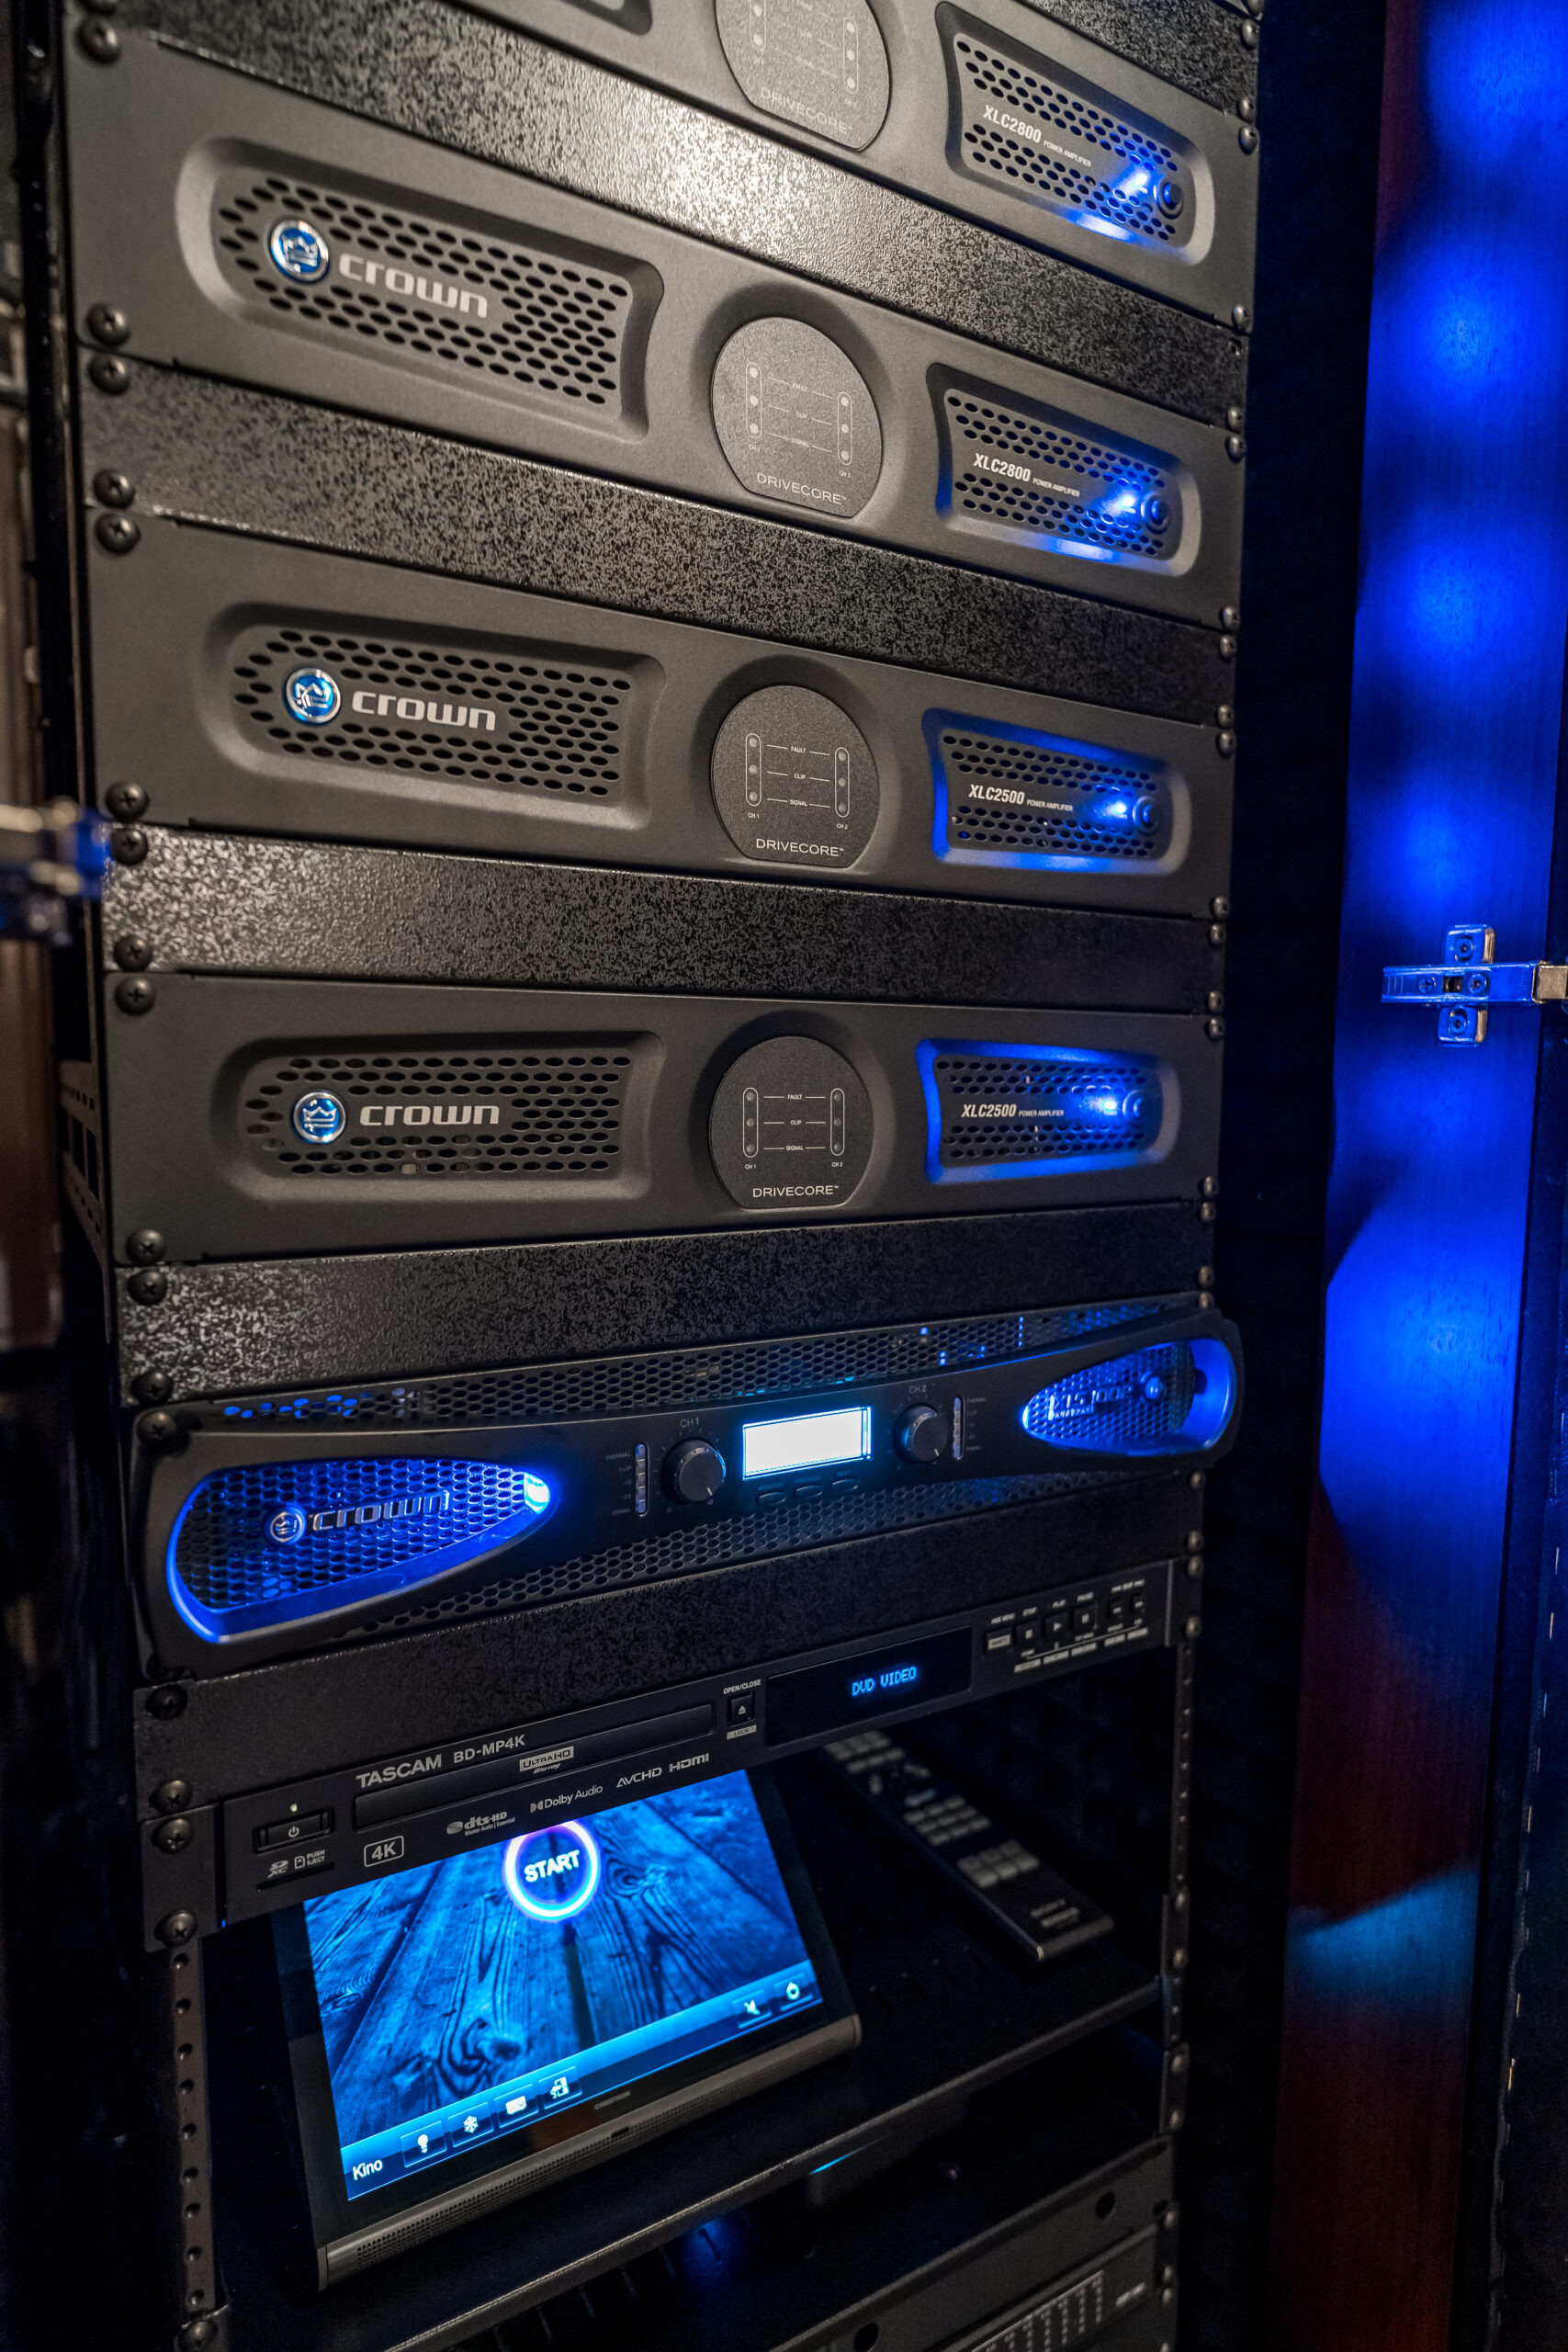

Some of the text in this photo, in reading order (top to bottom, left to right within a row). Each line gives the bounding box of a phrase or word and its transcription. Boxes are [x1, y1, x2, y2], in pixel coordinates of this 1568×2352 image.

[983, 104, 1092, 167] XLC2800 POWER AMPLIFIER
[339, 253, 488, 318] crown
[973, 453, 1080, 497] XLC2800 POWER AMPLIFIER
[352, 691, 496, 731] crown
[790, 798, 808, 807] SIGNAL
[968, 784, 1073, 813] XLC2500 POWER AMPLIFIER
[359, 1105, 500, 1126] crown
[962, 1103, 1017, 1118] XLC2500
[908, 1385, 927, 1394] CH 2
[681, 1419, 694, 1428] CH
[605, 1451, 631, 1461] THERMAL
[723, 1679, 761, 1695] OPEN/CLOSE
[852, 1666, 917, 1697] DVD VIDEO
[355, 1734, 526, 1788] TASCAM BD-MP4K
[533, 1762, 561, 1774] Blu-ray
[669, 1753, 710, 1773] HDMI
[616, 1767, 662, 1788] AVCHD
[544, 1784, 604, 1809] Dolby Audio
[465, 1827, 480, 1837] Master
[480, 1823, 494, 1832] Audio
[307, 1849, 325, 1859] PUSH
[371, 1840, 396, 1860] 4K
[307, 1856, 325, 1866] EJECT
[524, 1849, 581, 1883] START
[352, 2159, 384, 2181] Kino
